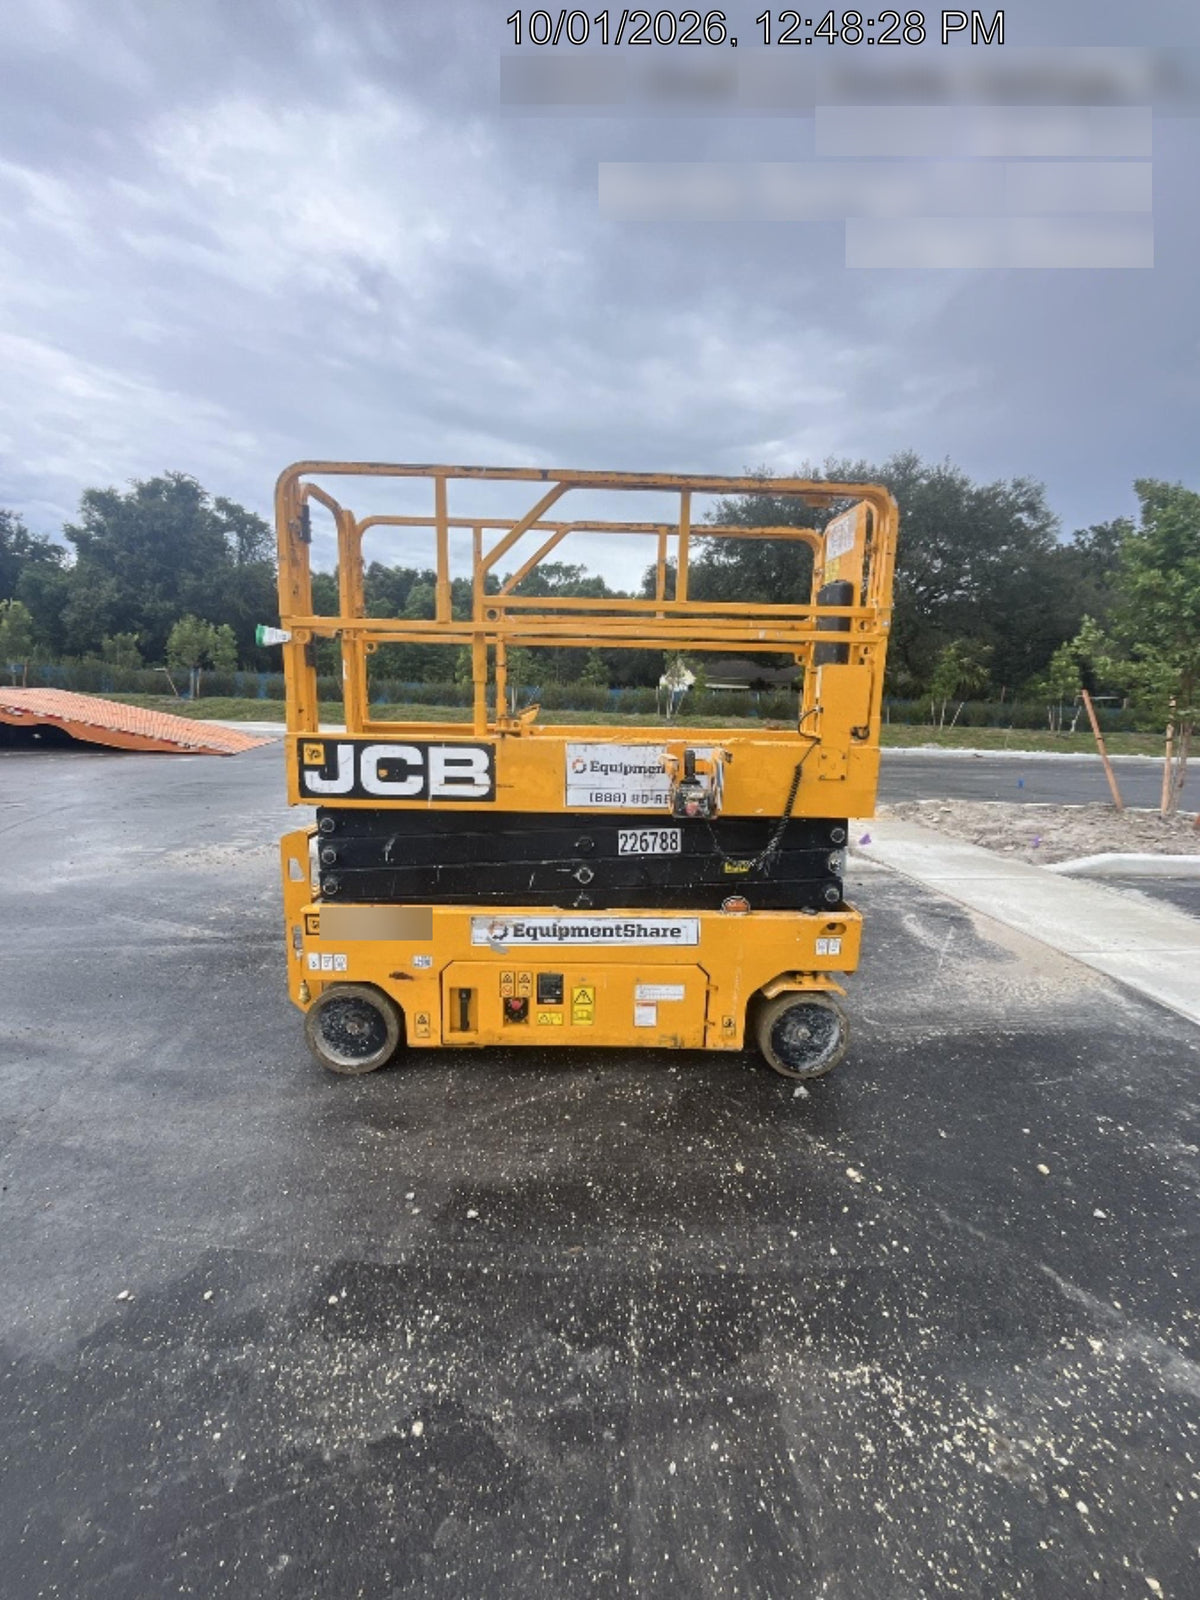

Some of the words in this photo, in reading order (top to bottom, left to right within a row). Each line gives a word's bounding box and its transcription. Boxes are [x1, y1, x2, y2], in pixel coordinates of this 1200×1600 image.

[303, 744, 491, 797] JCB
[589, 760, 666, 776] Equipmen
[589, 792, 627, 804] (888)
[619, 831, 679, 853] 226788
[513, 923, 682, 941] EquipmentShare
